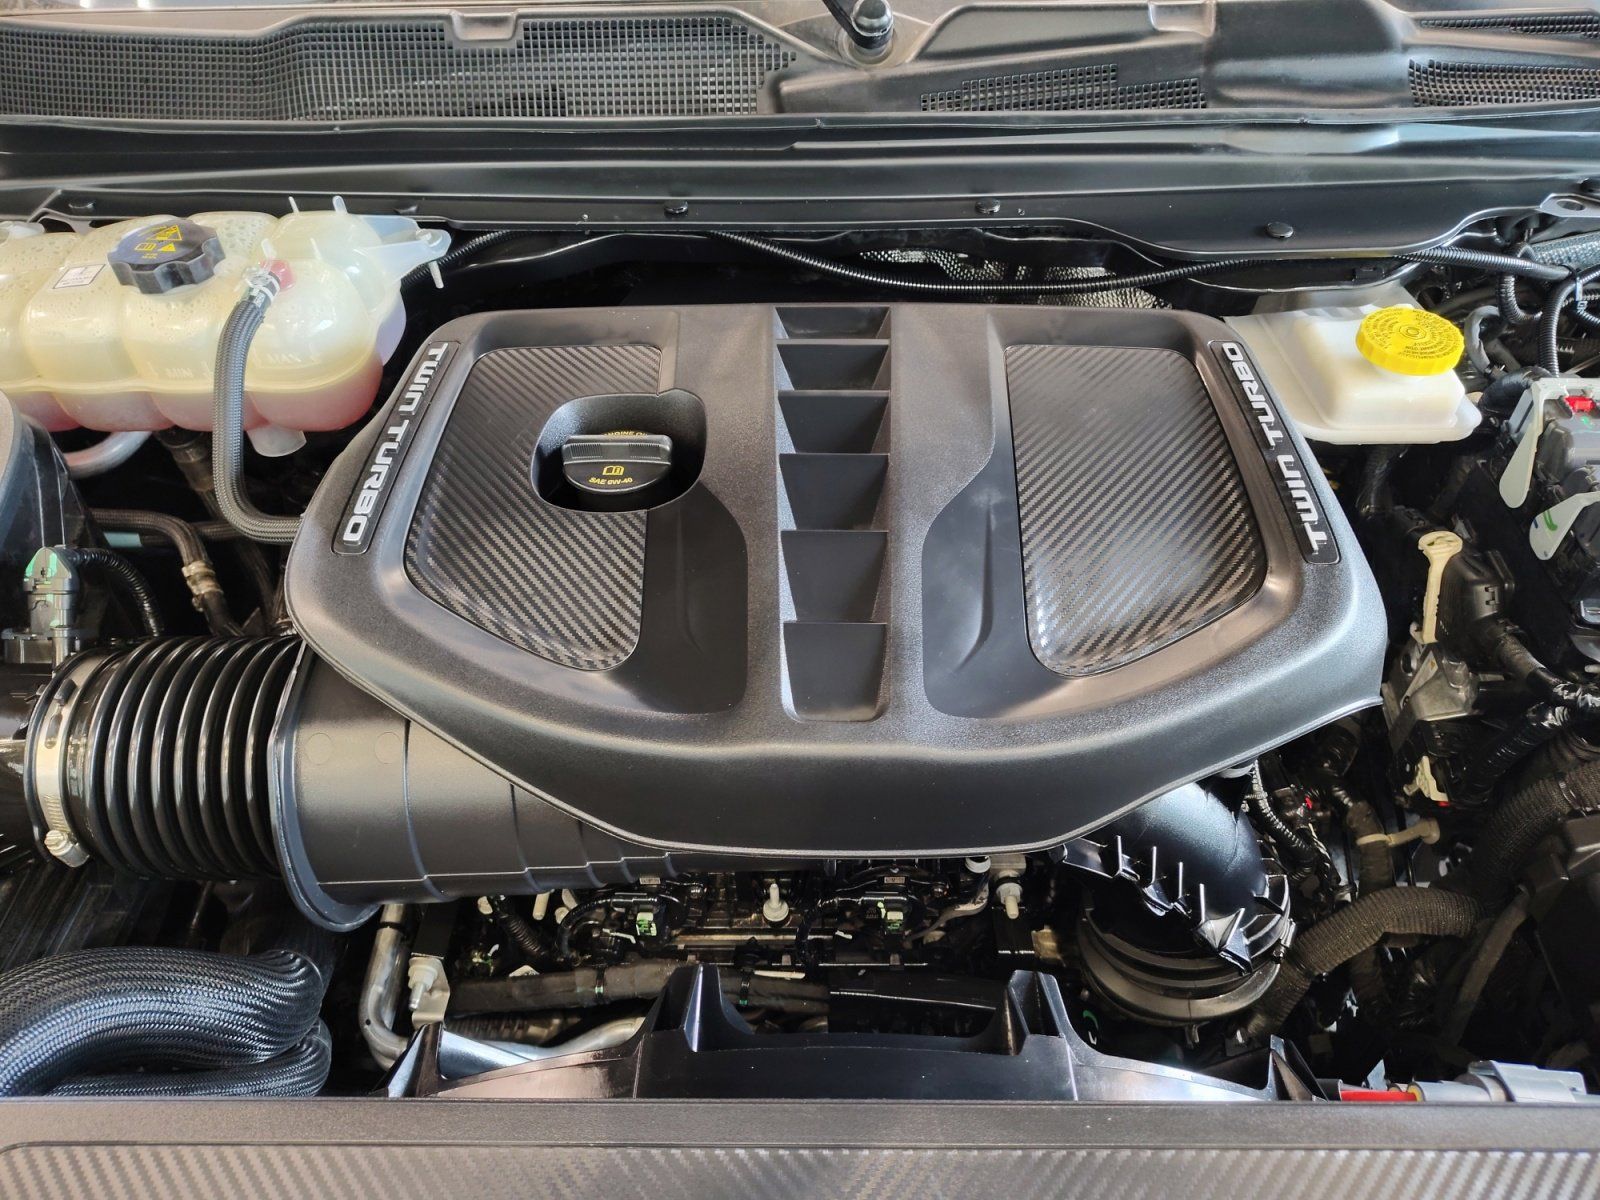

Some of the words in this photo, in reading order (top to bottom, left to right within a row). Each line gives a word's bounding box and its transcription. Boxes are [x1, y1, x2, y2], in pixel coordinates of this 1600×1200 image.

[398, 342, 449, 415] TWIN
[1221, 342, 1284, 449] TURBO
[342, 419, 410, 544] TURBO
[1276, 454, 1328, 555] TWIN
